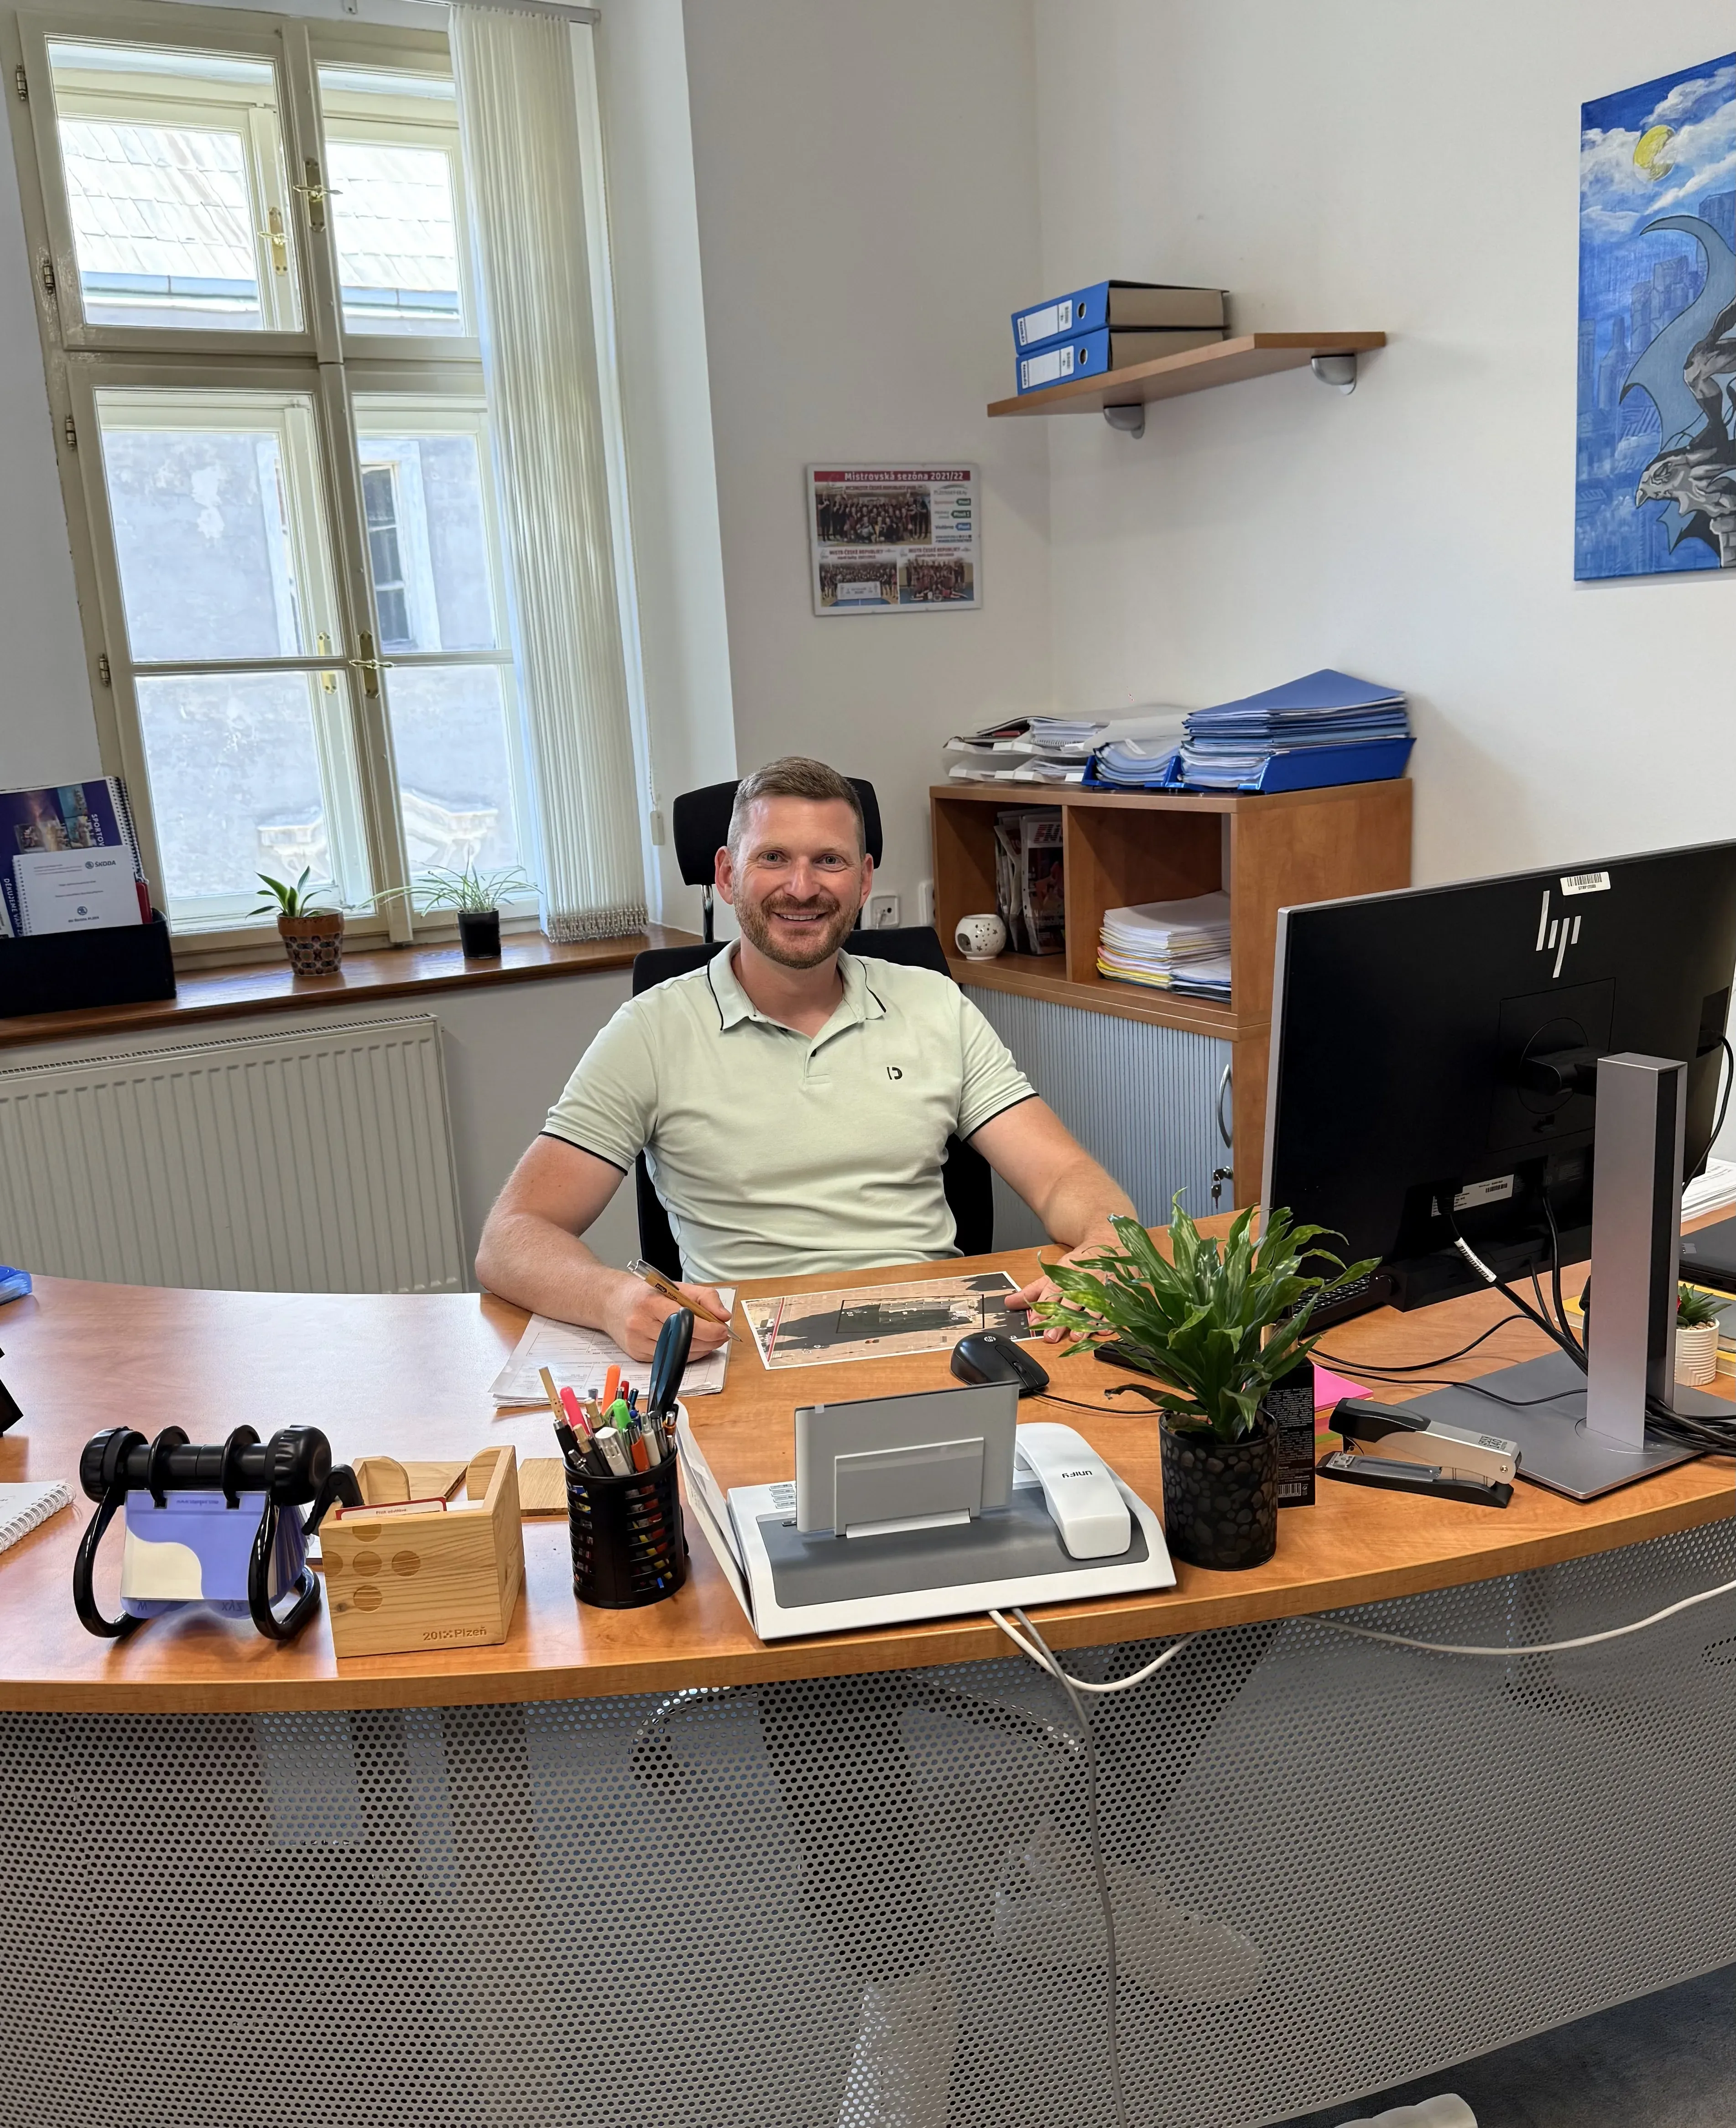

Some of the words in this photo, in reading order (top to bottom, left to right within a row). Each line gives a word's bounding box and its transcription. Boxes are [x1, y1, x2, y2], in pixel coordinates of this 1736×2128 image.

[845, 472, 895, 481] Mistrovská
[897, 472, 928, 480] sezóna
[930, 471, 964, 480] 2021/22
[1536, 890, 1581, 978] hp
[1489, 1439, 1502, 1449] 140
[454, 1626, 487, 1638] Plzeň
